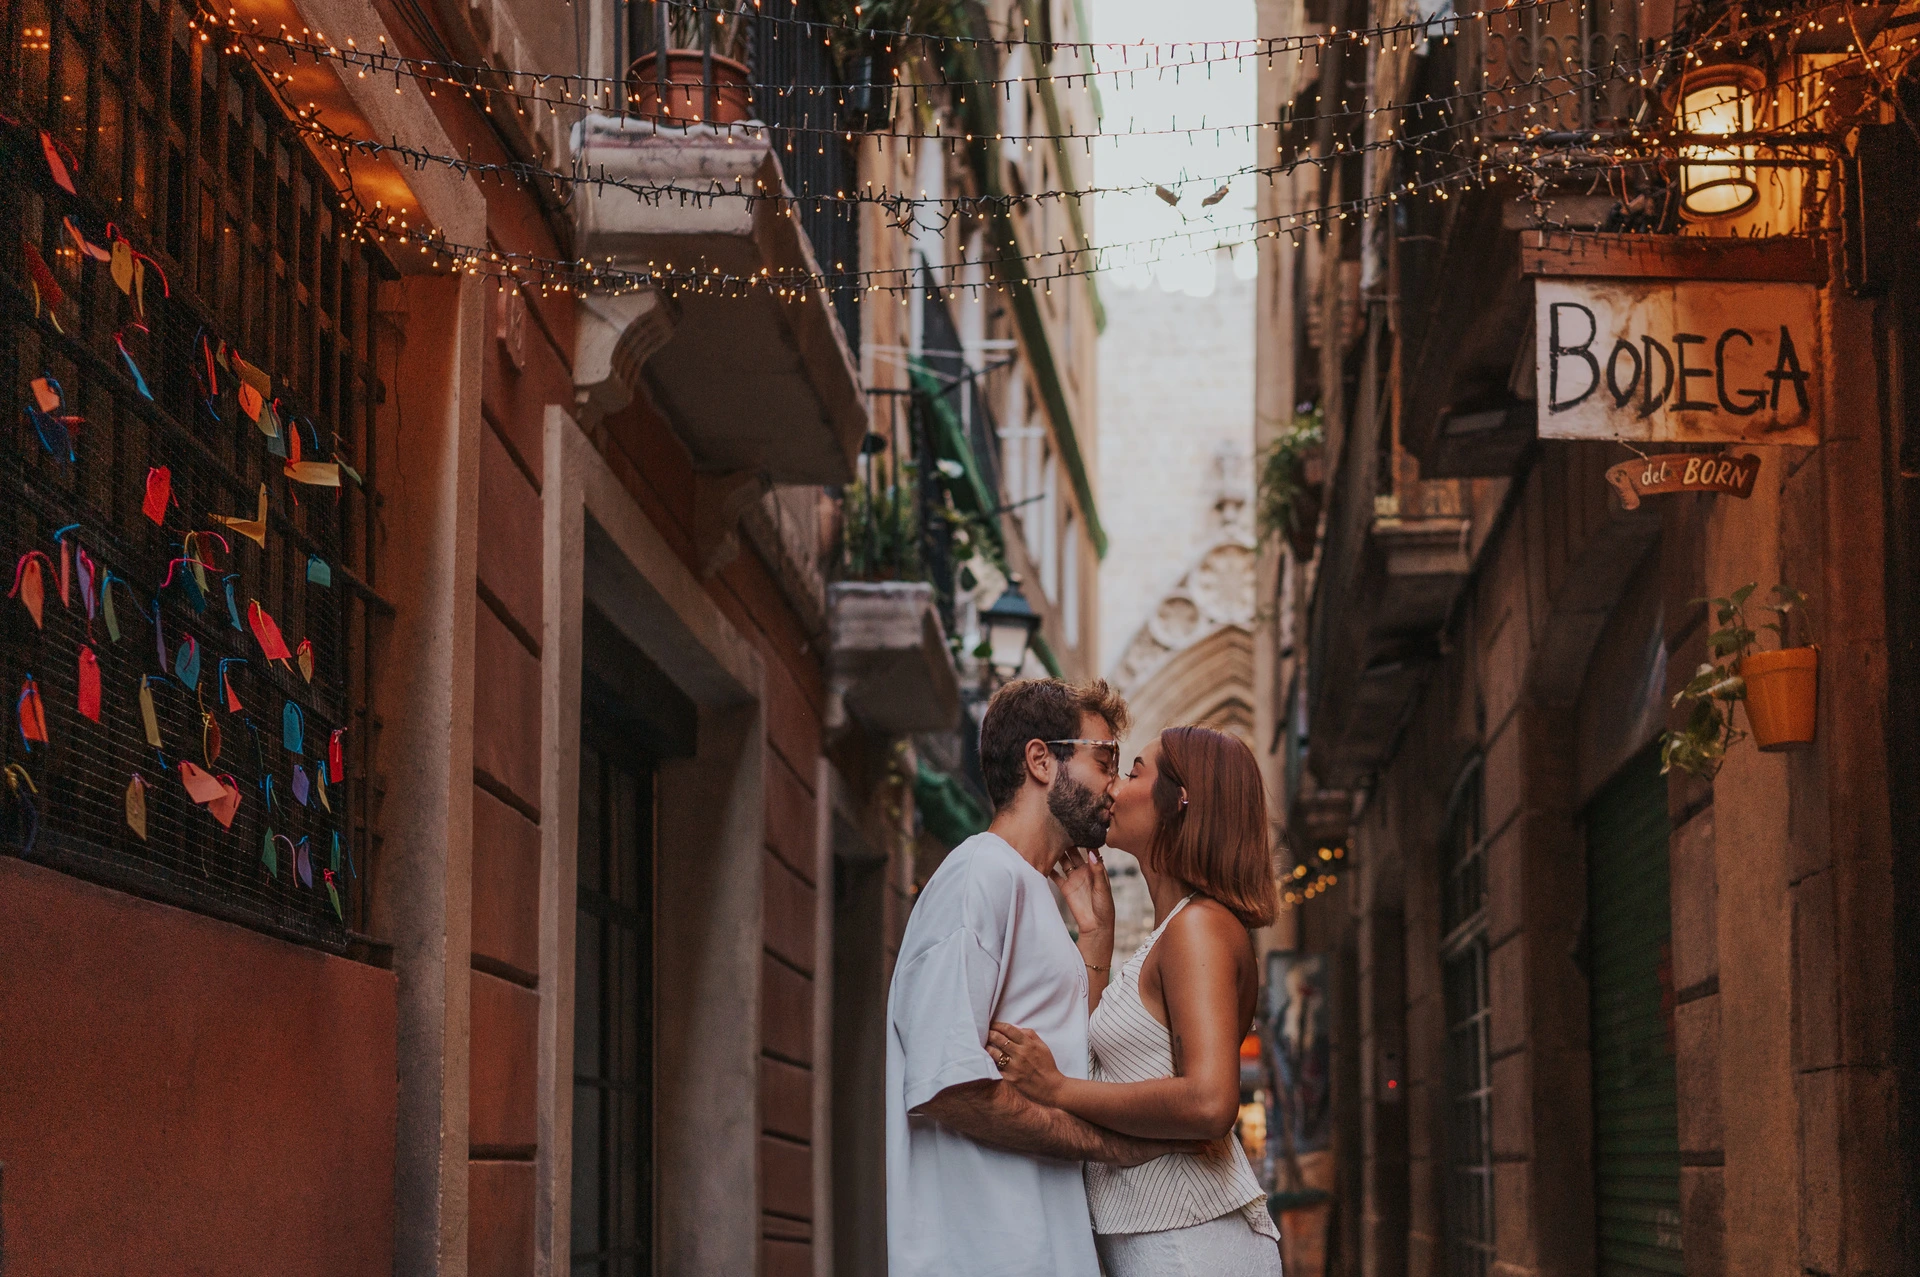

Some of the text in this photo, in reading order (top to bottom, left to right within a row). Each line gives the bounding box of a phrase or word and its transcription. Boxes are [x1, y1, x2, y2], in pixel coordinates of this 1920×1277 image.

[1548, 302, 1811, 426] BODEGA
[1641, 457, 1749, 488] del BORN
